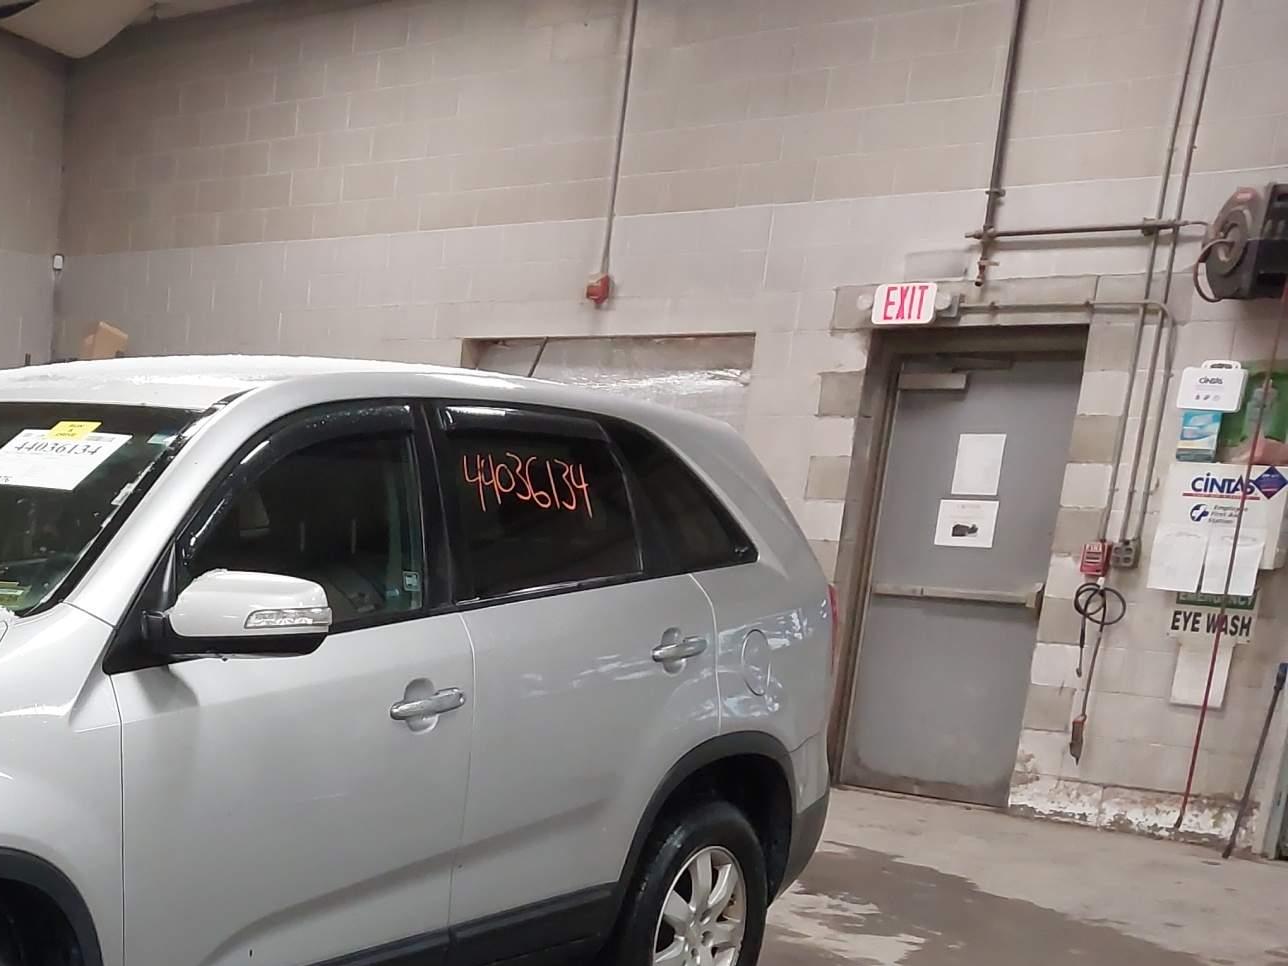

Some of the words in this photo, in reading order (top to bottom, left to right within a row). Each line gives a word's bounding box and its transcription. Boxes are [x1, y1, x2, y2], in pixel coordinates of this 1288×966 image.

[883, 285, 929, 320] EXIT
[14, 441, 102, 456] 44036134
[463, 452, 593, 519] 44036134
[1191, 471, 1256, 495] CINTAS
[1170, 610, 1202, 632] EYE
[1206, 613, 1252, 637] WASH
